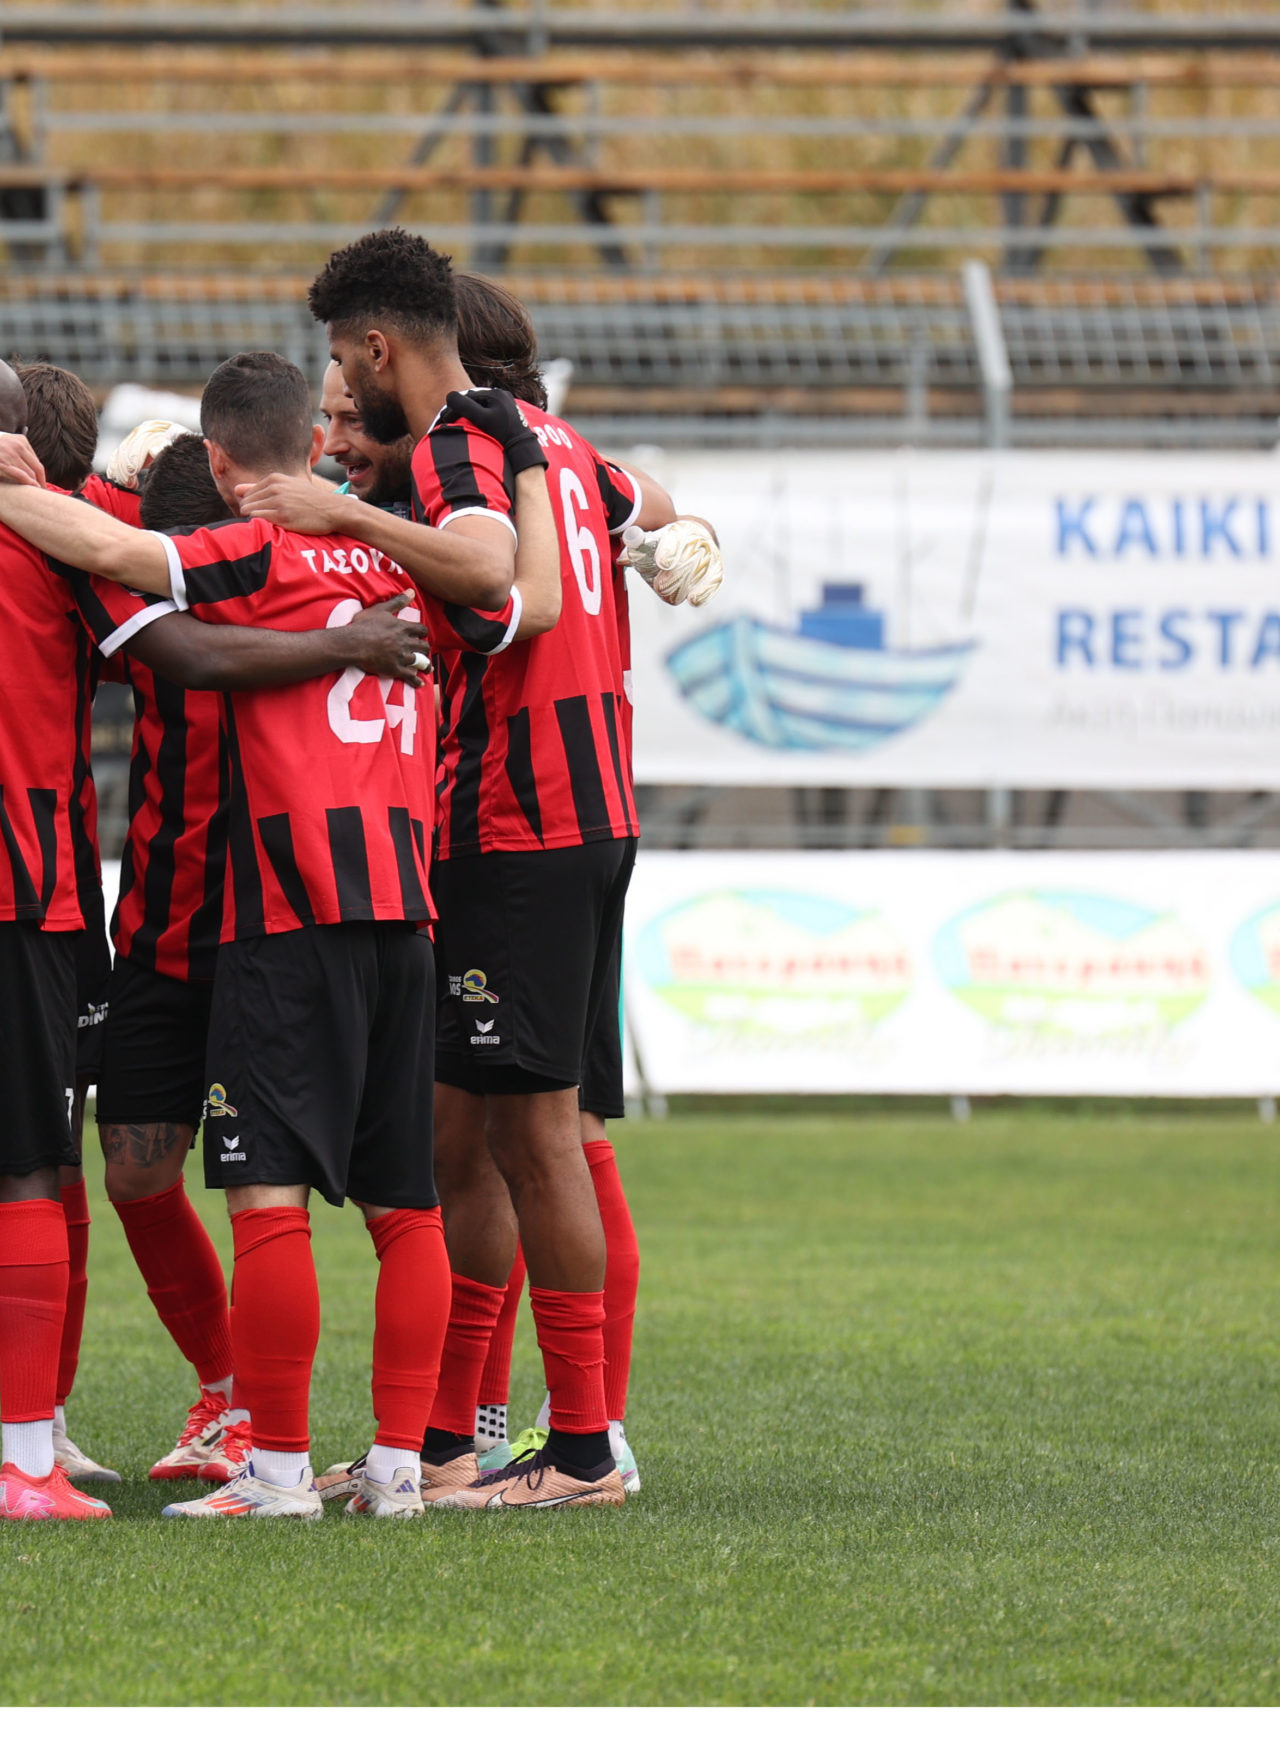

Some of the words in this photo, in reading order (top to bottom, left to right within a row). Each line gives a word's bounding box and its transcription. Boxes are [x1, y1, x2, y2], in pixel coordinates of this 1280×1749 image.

[558, 466, 603, 616] 6
[1053, 494, 1270, 557] KAIKI
[1054, 606, 1280, 668] RESTA
[470, 1034, 500, 1045] erima
[220, 1152, 247, 1162] erima
